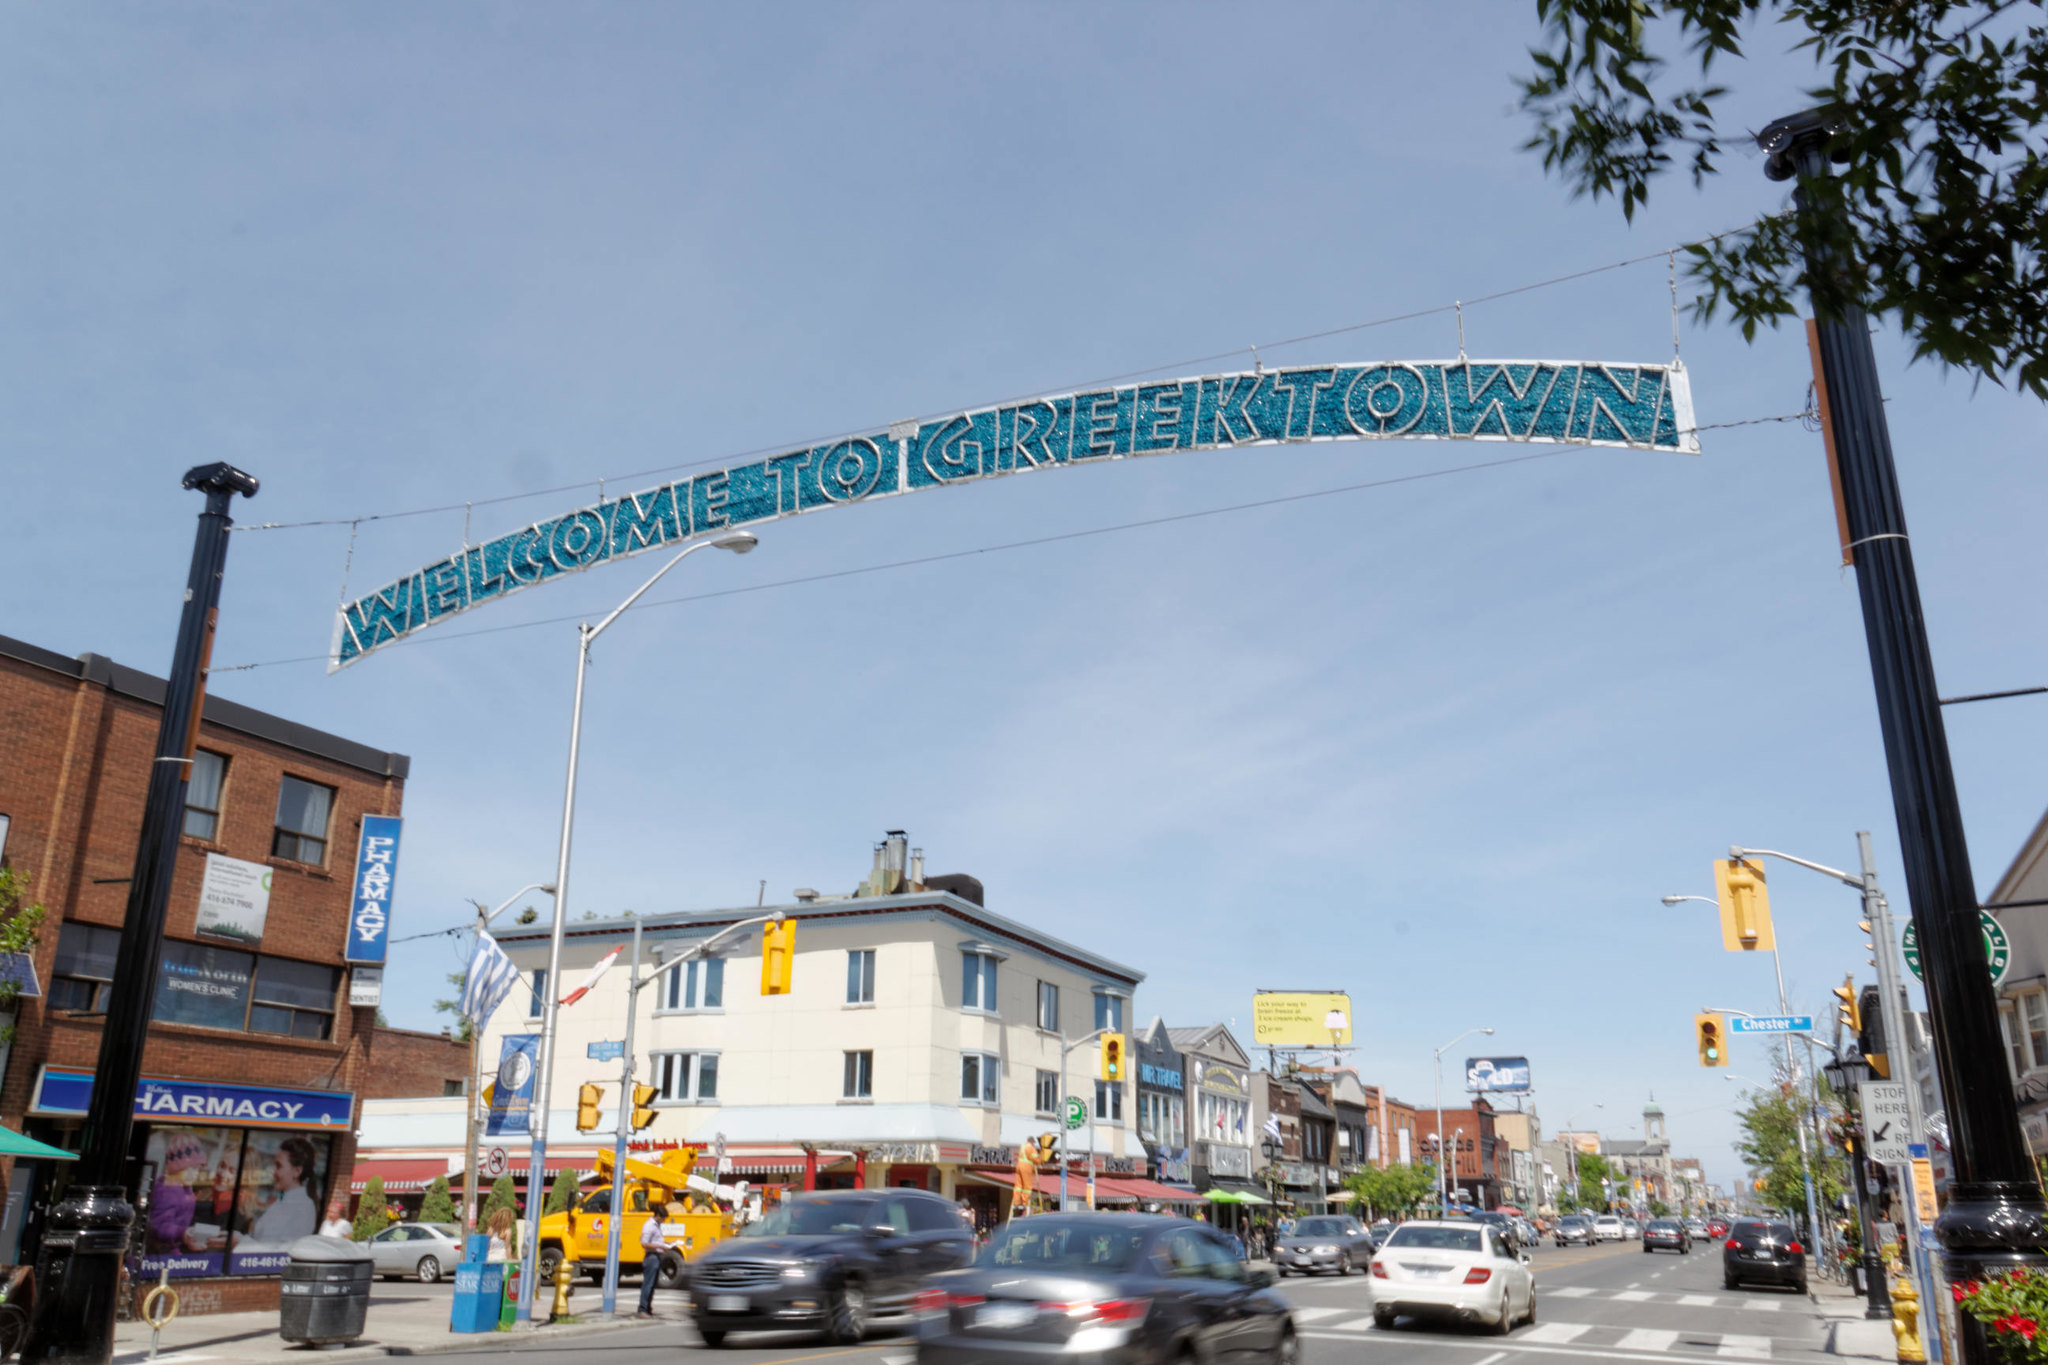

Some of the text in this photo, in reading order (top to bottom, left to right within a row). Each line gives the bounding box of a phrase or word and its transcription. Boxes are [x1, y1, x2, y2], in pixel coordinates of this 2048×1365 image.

[342, 361, 1671, 653] WELCOME TO GREEKTOWN
[356, 836, 394, 941] PHARMACY
[168, 977, 237, 997] WOMEN'S CLINIC
[1741, 1018, 1790, 1030] Chester
[1156, 1066, 1183, 1090] TRAVEL
[134, 1091, 304, 1119] HARMACY
[1874, 1103, 1910, 1114] HERE
[141, 1257, 210, 1271] Free Delivery
